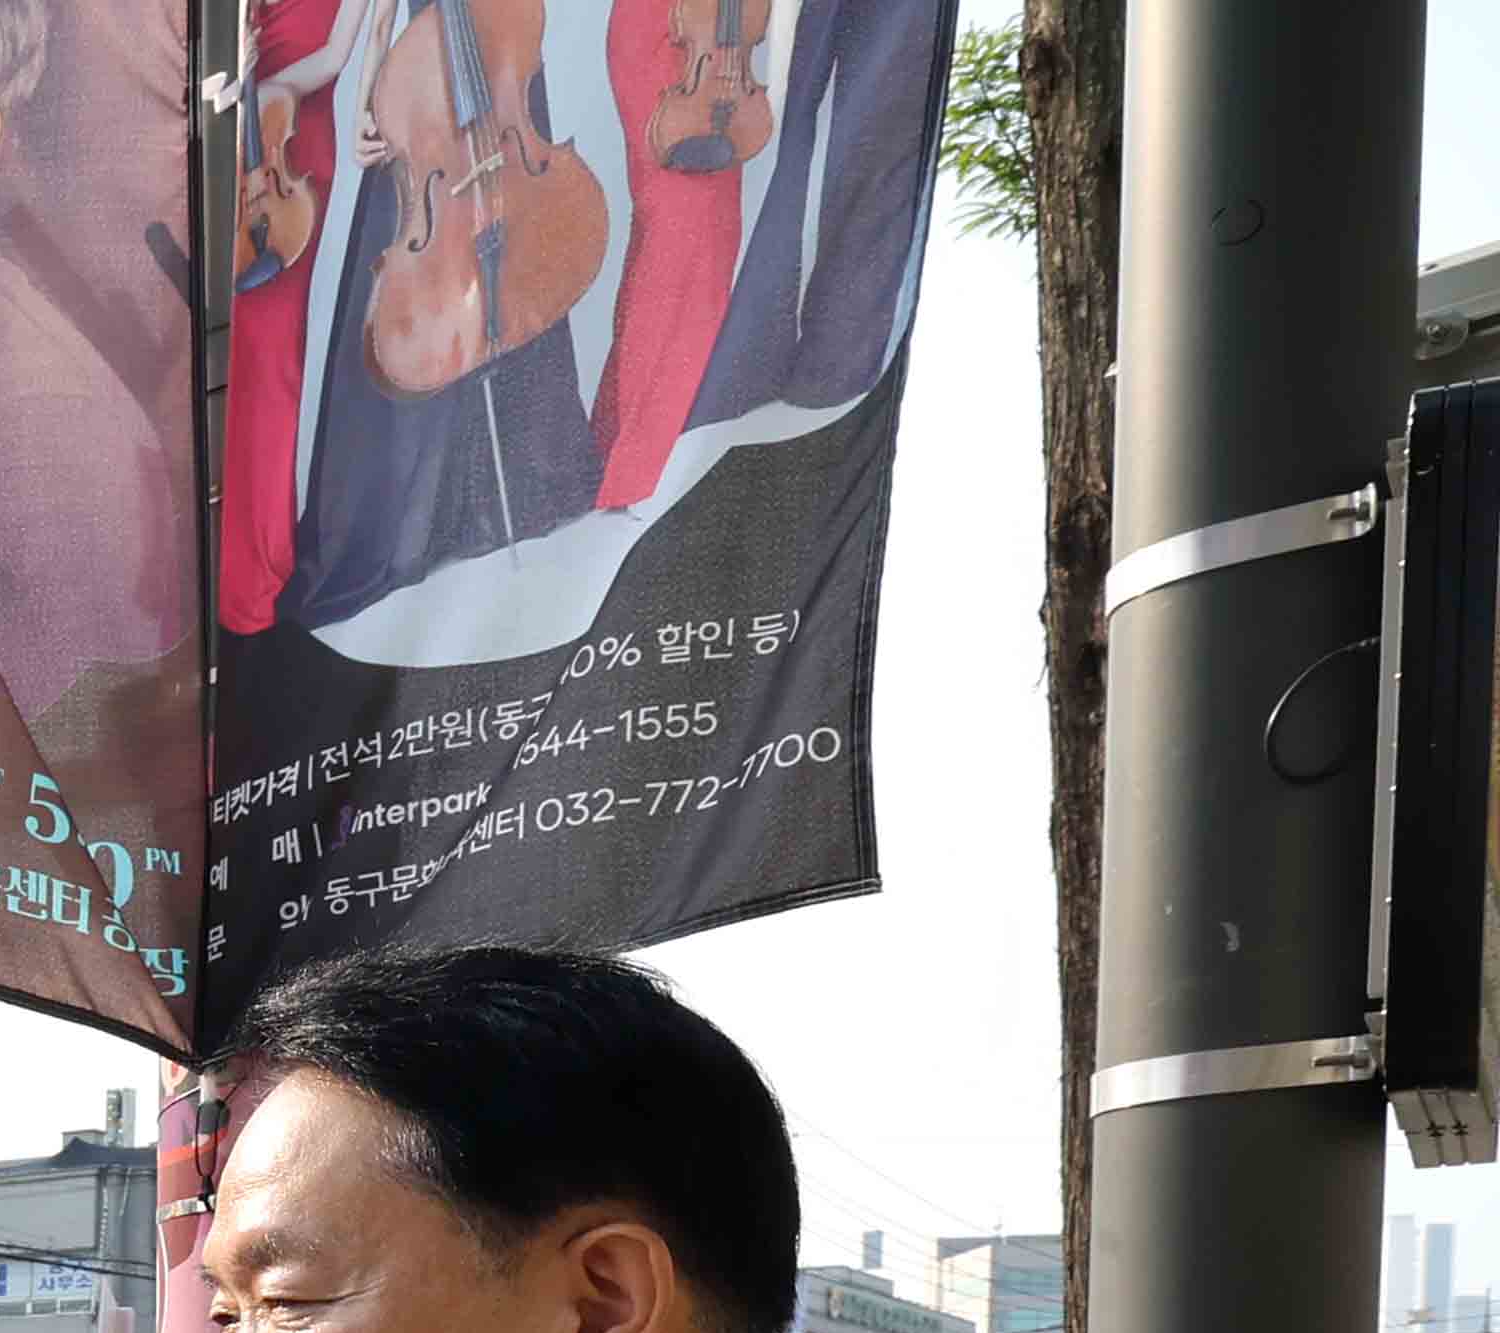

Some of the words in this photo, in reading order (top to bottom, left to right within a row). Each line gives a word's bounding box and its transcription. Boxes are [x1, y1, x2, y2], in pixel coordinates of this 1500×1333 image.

[211, 760, 301, 825] 티켓가격
[320, 731, 382, 783] 전석
[560, 633, 642, 684] 0%
[657, 618, 735, 665] 할인
[748, 609, 800, 656] 등)
[350, 782, 493, 835] interpark
[513, 700, 719, 770] 1544-1555
[535, 727, 842, 832] 032-772-1700
[145, 847, 181, 875] PM
